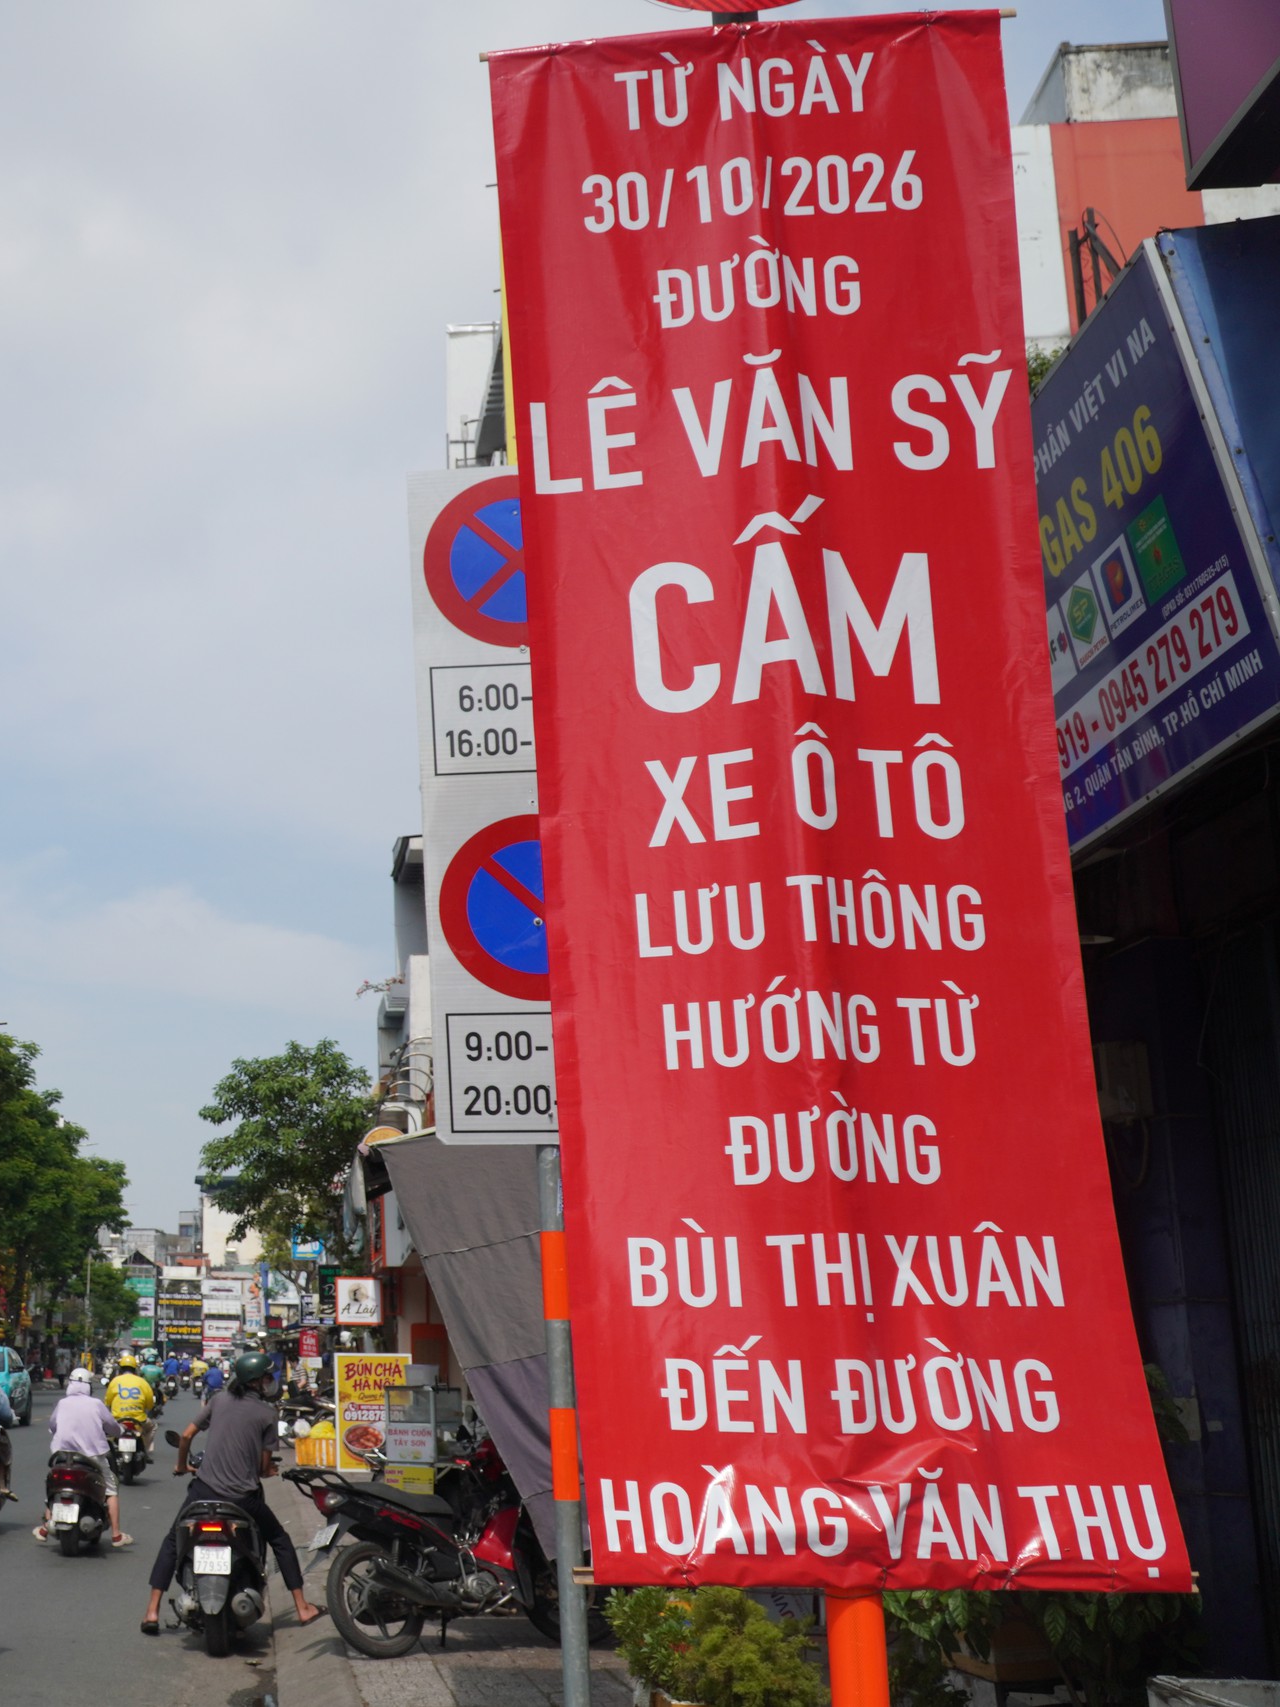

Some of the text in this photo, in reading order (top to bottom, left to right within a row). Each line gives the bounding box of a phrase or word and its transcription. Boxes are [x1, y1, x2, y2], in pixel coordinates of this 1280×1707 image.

[614, 40, 874, 131] TỪ NGÀY
[581, 150, 923, 234] 30/10/2026
[653, 235, 861, 329] ĐƯỜNG
[529, 349, 1013, 495] LÊ VĂN SỸ
[1069, 373, 1106, 433] VIỆT
[1105, 349, 1128, 388] VI
[1126, 317, 1156, 365] NA
[1039, 476, 1097, 577] GAS
[1100, 405, 1162, 510] 406
[628, 494, 941, 714] CẤM
[1110, 598, 1144, 633] PETROLIMEX
[1098, 660, 1149, 733] 0945
[1147, 625, 1192, 694] 279
[1190, 585, 1239, 660] 279
[1084, 767, 1110, 792] QUẬN
[1110, 745, 1131, 776] TÂN
[1199, 671, 1226, 709] CHÍ
[1225, 648, 1264, 692] MINH
[644, 721, 965, 848] XE Ô TÔ
[634, 868, 986, 958] LƯU THÔNG
[662, 975, 980, 1071] HƯỚNG TỪ
[724, 1091, 941, 1186] ĐƯỜNG
[627, 1217, 1065, 1323] BÙI THỊ XUÂN
[118, 1384, 141, 1400] be
[344, 1359, 402, 1381] BÚN CHẢ
[352, 1376, 371, 1392] HÀ
[660, 1335, 1060, 1434] ĐẾN ĐƯỜNG
[600, 1463, 1167, 1578] HOÀNG VĂN THỤ
